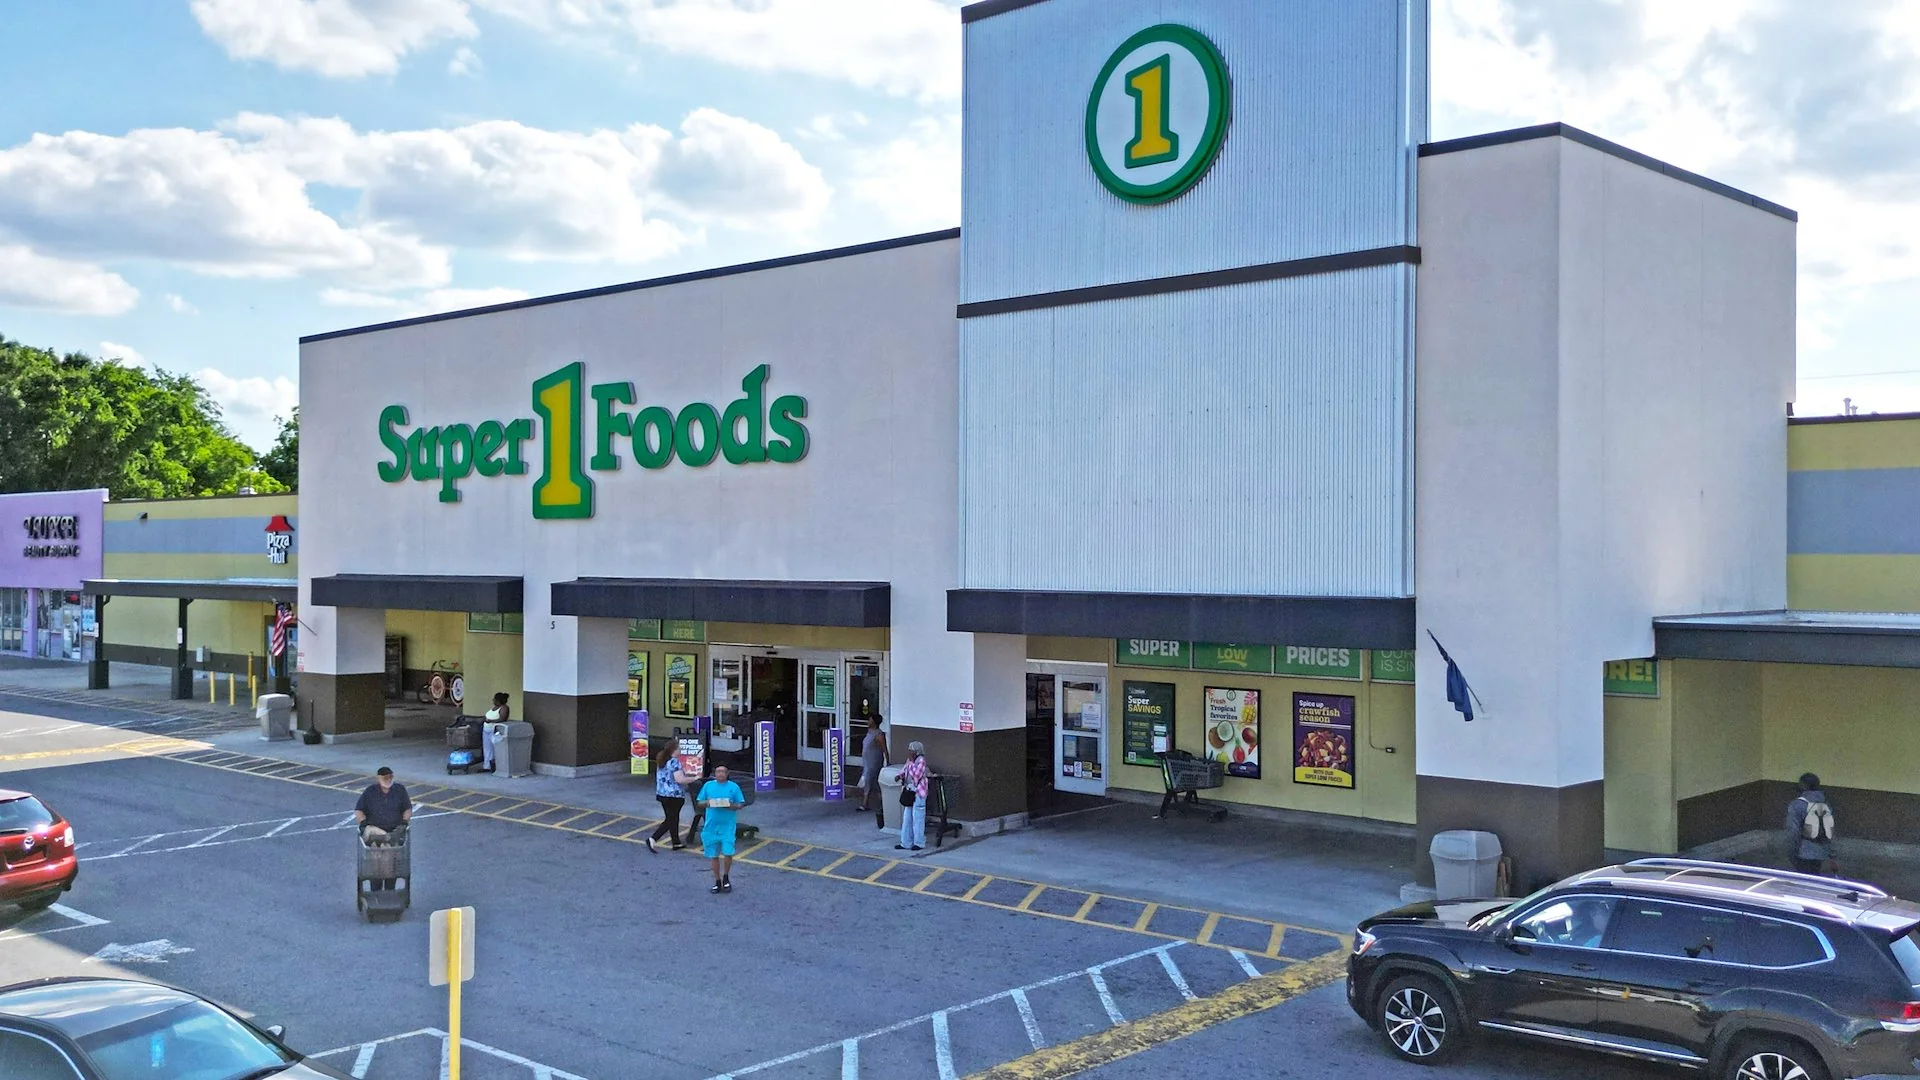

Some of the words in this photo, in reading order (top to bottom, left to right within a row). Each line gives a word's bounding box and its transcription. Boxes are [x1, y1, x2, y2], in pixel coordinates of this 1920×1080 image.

[1125, 53, 1179, 169] 1
[377, 405, 535, 503] Super
[532, 361, 596, 519] 1
[590, 363, 810, 472] Foods
[267, 531, 291, 549] Pizza
[268, 547, 287, 564] Hut
[550, 620, 556, 630] 5
[672, 628, 696, 640] HERE
[1129, 639, 1180, 657] SUPER
[1217, 648, 1248, 660] LOW
[1286, 646, 1350, 667] PRICES
[1381, 660, 1394, 671] IS
[1604, 660, 1653, 682] RE!
[1128, 695, 1150, 706] Super
[1299, 700, 1315, 708] Spice
[1128, 704, 1161, 714] SAVINGS
[1210, 705, 1236, 713] Tropical
[1299, 707, 1341, 717] crawfish
[1210, 713, 1238, 721] favorites
[1299, 714, 1331, 723] season
[763, 729, 772, 777] crawfish
[831, 736, 841, 786] crawfish
